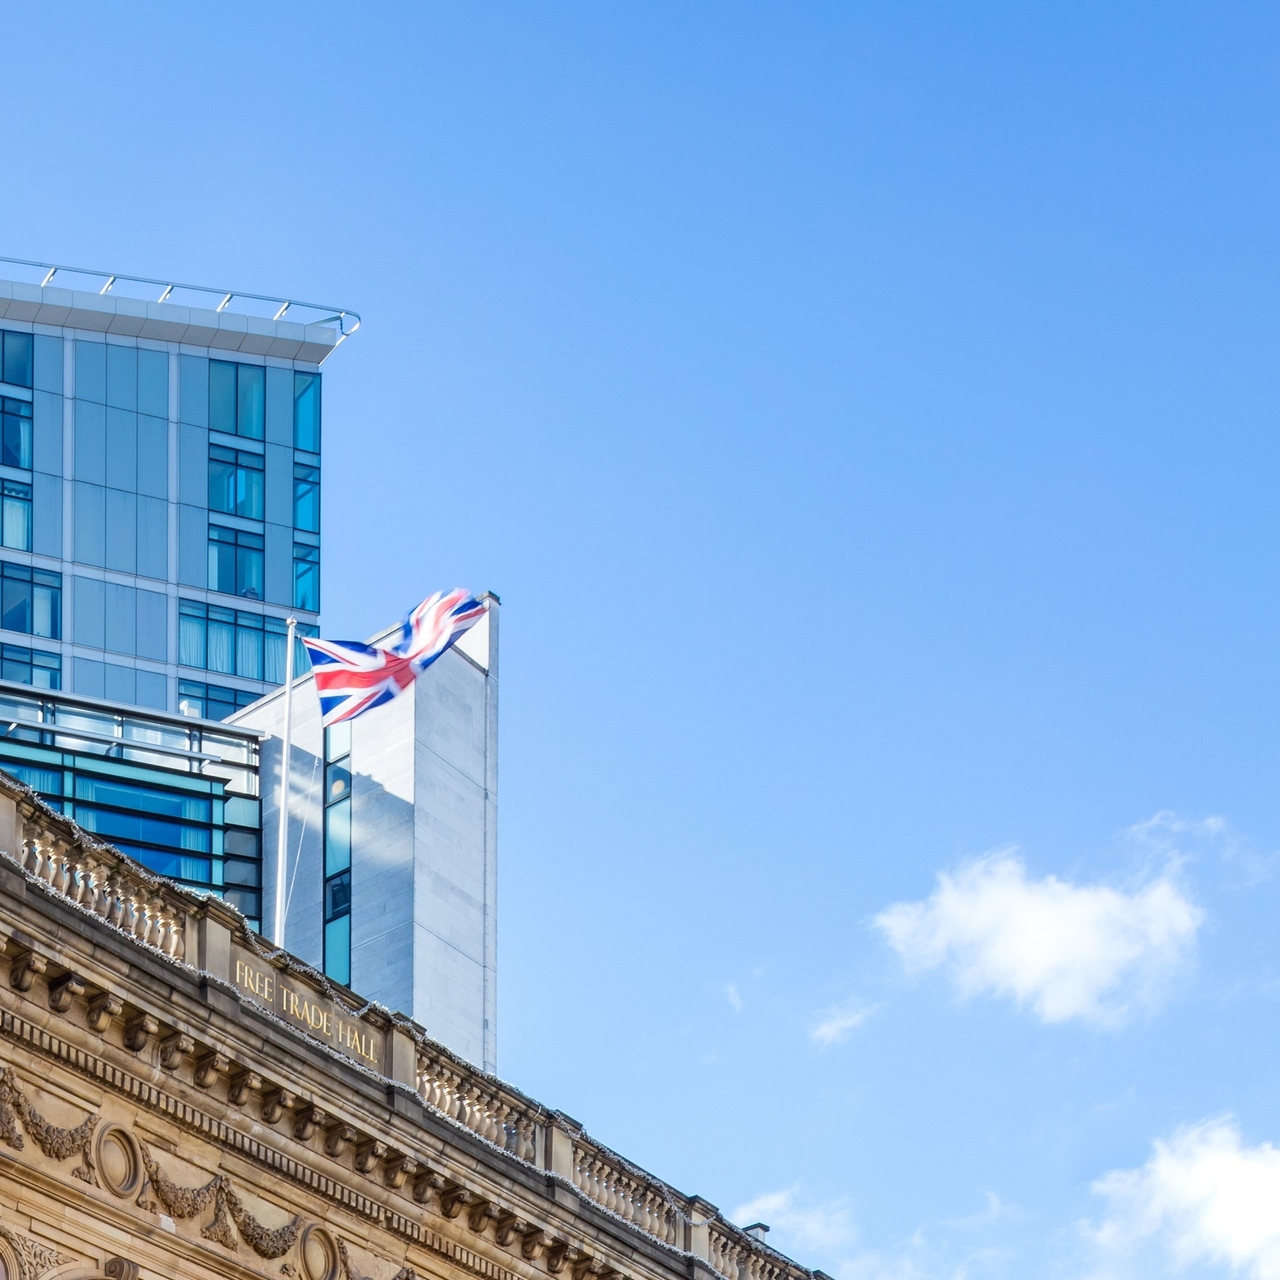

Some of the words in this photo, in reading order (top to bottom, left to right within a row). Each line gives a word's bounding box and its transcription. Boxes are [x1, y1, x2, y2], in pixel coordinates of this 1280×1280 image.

[236, 959, 273, 1002] FREE
[279, 984, 332, 1036] TRADE
[338, 1020, 378, 1063] HALL
